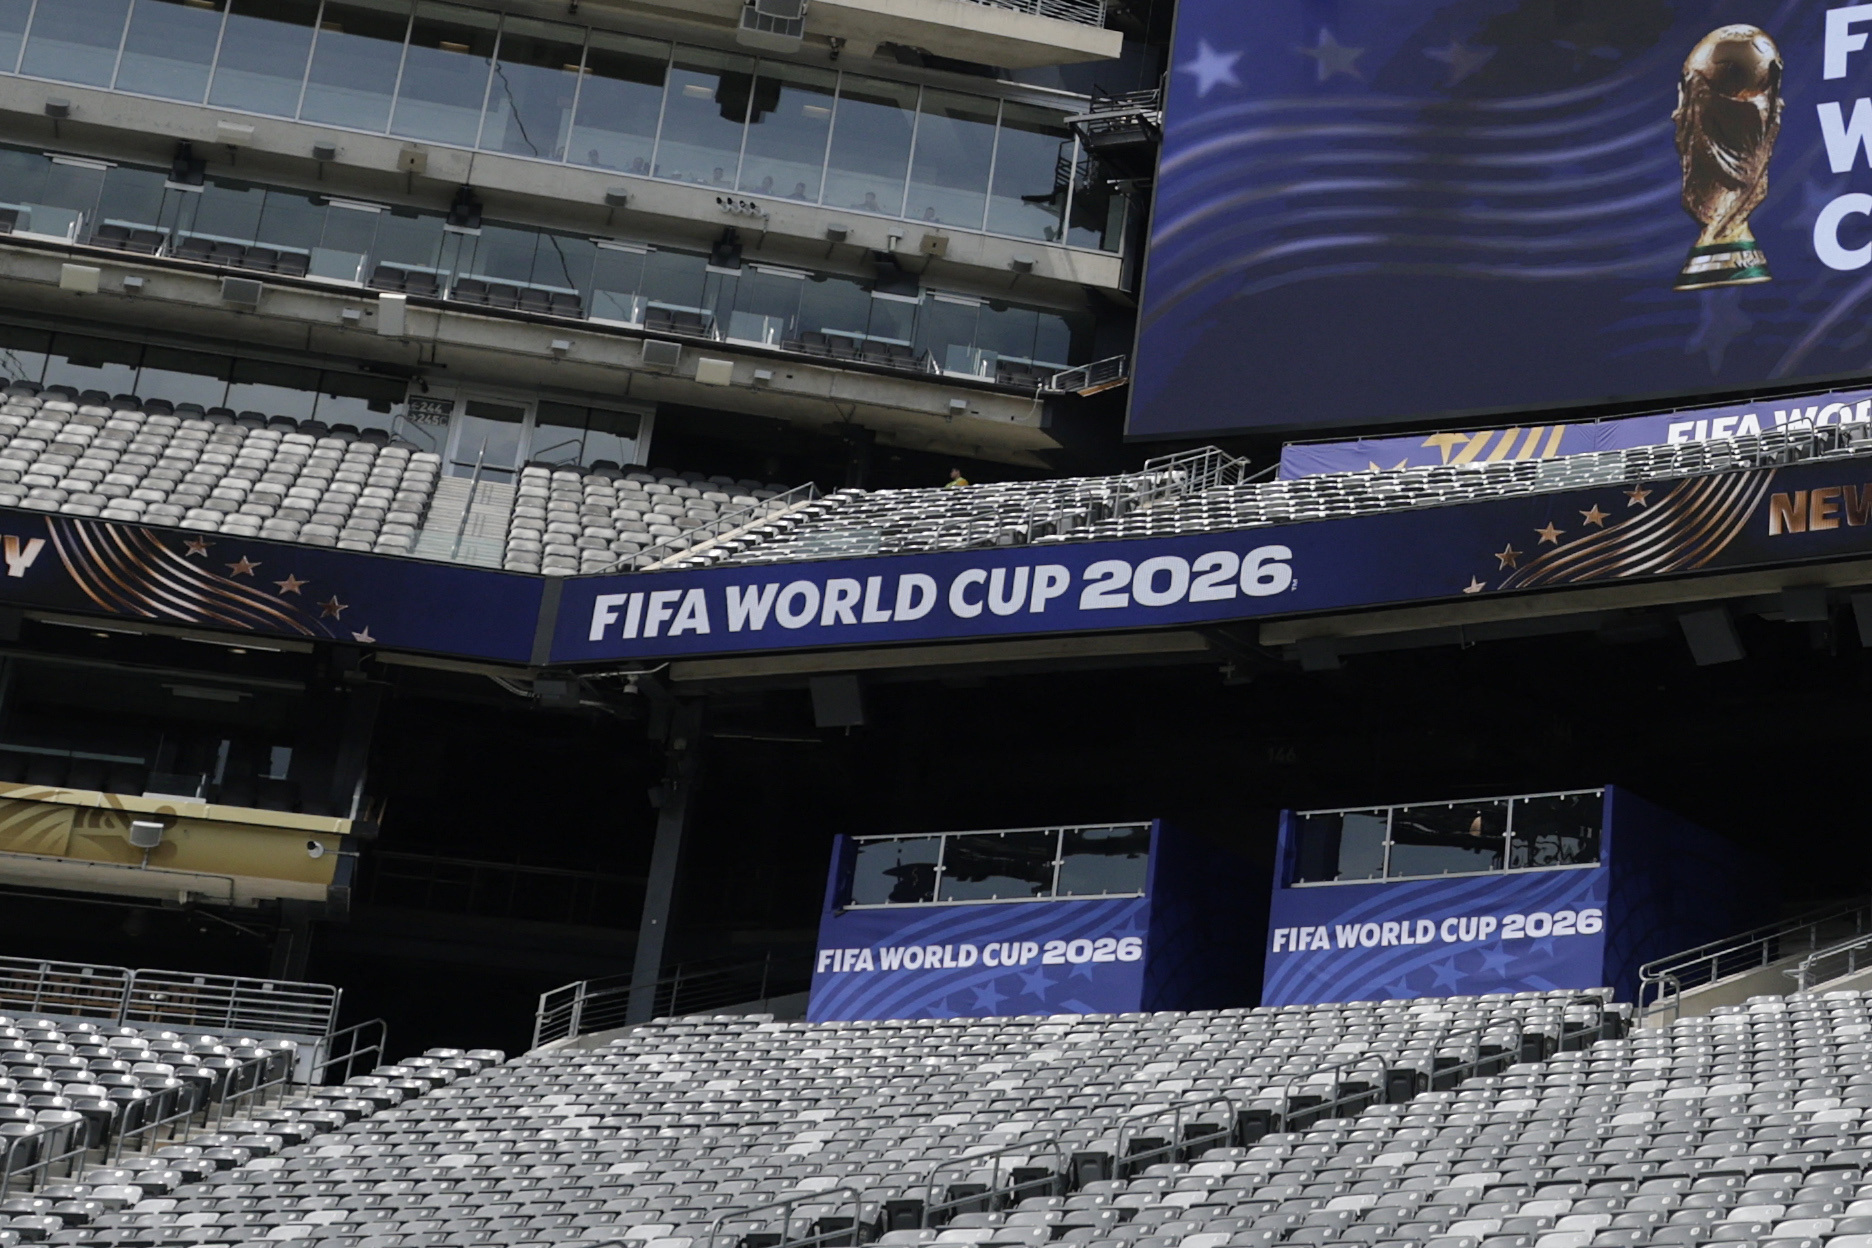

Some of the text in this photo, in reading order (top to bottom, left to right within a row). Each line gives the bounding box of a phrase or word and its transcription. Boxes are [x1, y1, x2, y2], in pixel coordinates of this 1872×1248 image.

[418, 401, 443, 414] 244
[588, 589, 711, 642] FIFA
[725, 575, 938, 633] WORLD
[948, 563, 1070, 619] CUP
[1078, 545, 1292, 611] 2026
[1272, 908, 1603, 952] FIFA WORLD CUP 2026
[817, 936, 1143, 973] FIFA WORLD CUP 2026
